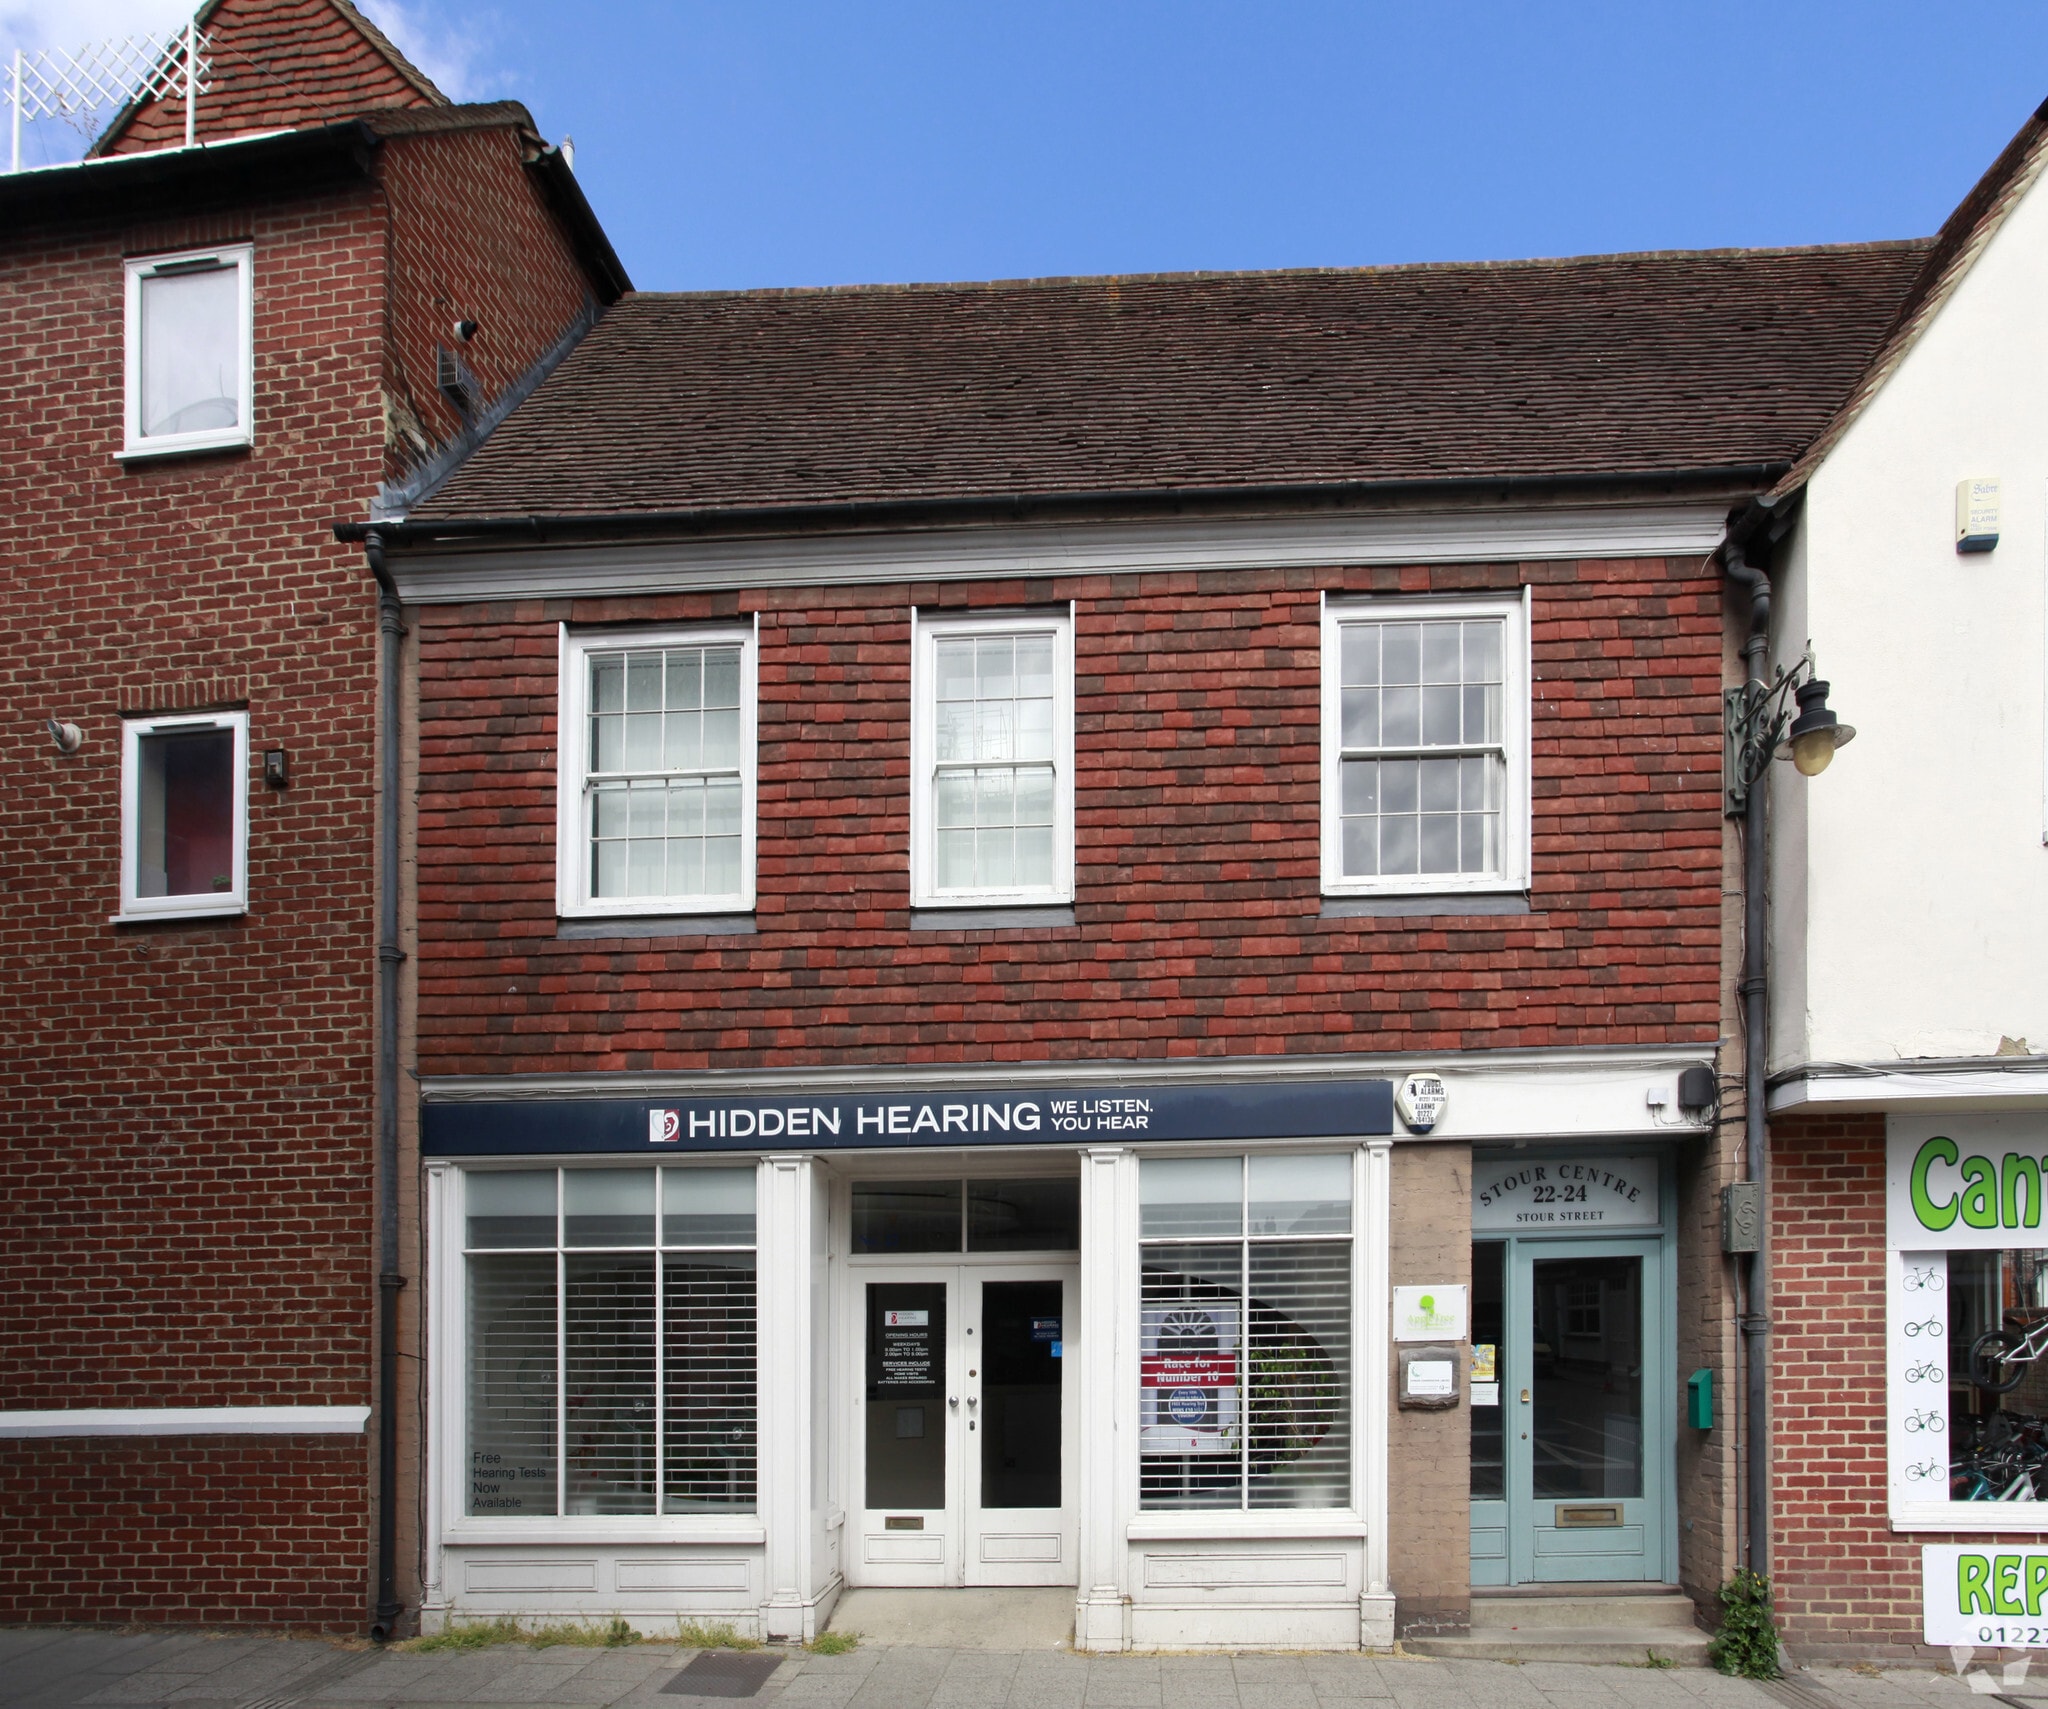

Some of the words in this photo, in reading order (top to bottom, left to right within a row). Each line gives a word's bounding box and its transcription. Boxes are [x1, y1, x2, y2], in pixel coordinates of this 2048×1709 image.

[1973, 484, 1998, 494] Sabre
[1420, 1087, 1444, 1095] ALARMS
[1051, 1101, 1079, 1114] WE
[1083, 1099, 1154, 1114] LISTEN.
[688, 1108, 841, 1138] HIDDEN
[857, 1103, 1041, 1135] HEARING
[1051, 1117, 1092, 1131] YOU
[1096, 1115, 1149, 1130] HEAR
[1480, 1166, 1548, 1208] STOUR
[1559, 1164, 1641, 1203] CENTRE
[1533, 1185, 1588, 1203] 22-24
[1516, 1211, 1555, 1223] STOUR
[1560, 1210, 1604, 1222] STREET
[1164, 1358, 1191, 1369] Race
[1195, 1357, 1211, 1368] for
[1156, 1371, 1202, 1383] Number
[1207, 1371, 1219, 1382] 10
[473, 1452, 501, 1464] Free
[473, 1467, 515, 1480] Hearing
[518, 1467, 546, 1478] Tests
[473, 1482, 500, 1493] Now
[473, 1497, 521, 1508] Available
[1957, 1554, 2048, 1616] REP
